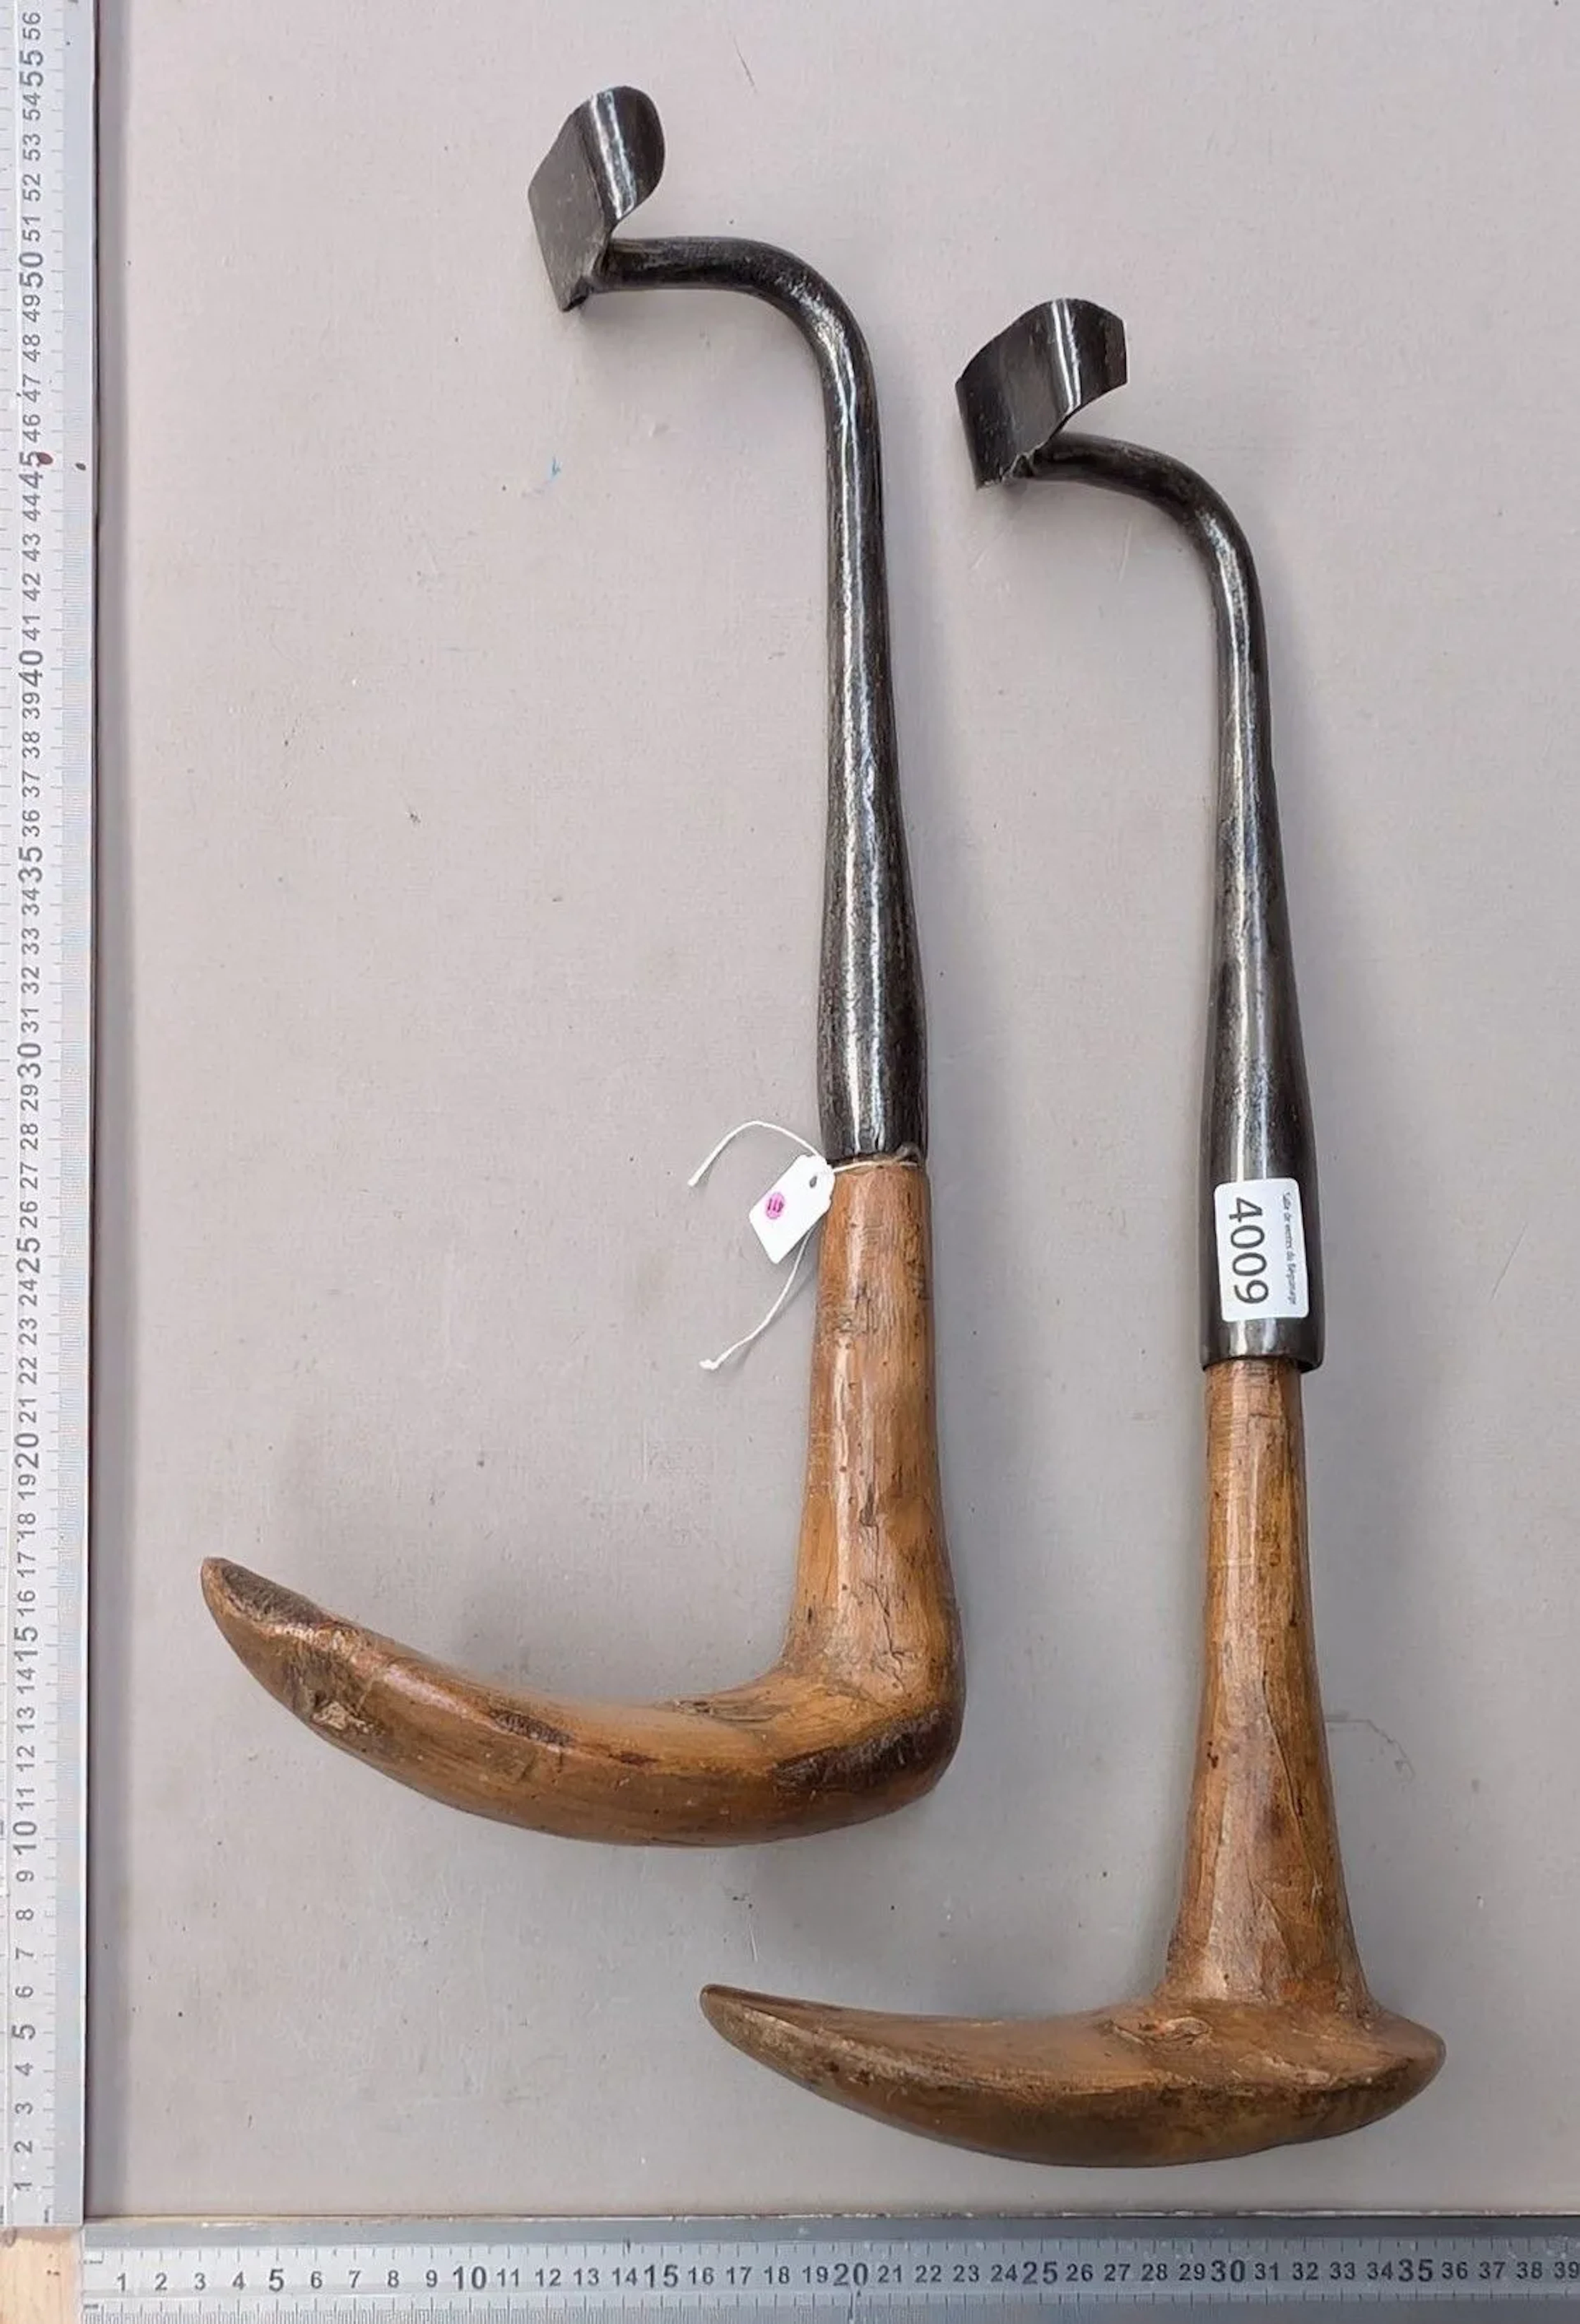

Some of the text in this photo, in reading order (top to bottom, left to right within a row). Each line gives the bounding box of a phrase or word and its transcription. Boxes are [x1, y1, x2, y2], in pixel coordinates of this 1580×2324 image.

[22, 13, 41, 40] 56
[19, 50, 43, 87] 55
[23, 93, 40, 121] 54
[23, 134, 41, 161] 53
[22, 174, 41, 201] 52
[22, 217, 40, 242] 51
[19, 252, 43, 288] 50
[22, 295, 40, 323] 49
[23, 334, 40, 363] 48
[22, 374, 40, 402] 47
[23, 414, 41, 442] 46
[19, 452, 43, 489] 45
[22, 494, 40, 522] 44
[22, 533, 40, 562] 43
[22, 573, 40, 601] 42
[22, 616, 40, 641] 41
[19, 651, 43, 687] 40
[22, 692, 40, 719] 39
[22, 731, 40, 758] 38
[22, 770, 40, 798] 37
[22, 810, 40, 837] 36
[18, 847, 42, 883] 35
[21, 888, 40, 916] 34
[21, 928, 39, 955] 33
[21, 967, 39, 994] 32
[21, 1008, 39, 1033] 31
[17, 1043, 41, 1078] 30
[20, 1084, 38, 1111] 29
[20, 1124, 38, 1150] 28
[20, 1162, 37, 1189] 27
[20, 1201, 37, 1228] 26
[16, 1238, 40, 1273] 25
[1229, 1197, 1269, 1304] 4009
[18, 1279, 37, 1306] 24
[18, 1318, 37, 1345] 23
[18, 1357, 37, 1384] 22
[18, 1399, 36, 1423] 21
[14, 1433, 39, 1468] 20
[18, 1474, 35, 1500] 19
[17, 1513, 35, 1539] 18
[17, 1552, 35, 1578] 17
[17, 1591, 35, 1617] 16
[14, 1627, 38, 1661] 15
[16, 1668, 35, 1694] 14
[16, 1707, 35, 1733] 13
[16, 1746, 35, 1772] 12
[16, 1789, 35, 1810] 11
[13, 1822, 37, 1855] 10
[16, 1870, 34, 1882] 9
[16, 1909, 34, 1921] 8
[16, 1947, 34, 1960] 7
[15, 1986, 33, 1998] 6
[11, 2024, 35, 2040] 5
[14, 2063, 33, 2076] 4
[14, 2102, 33, 2115] 3
[14, 2141, 32, 2153] 2
[117, 2259, 1579, 2292] 1 2 3 4 5 6 7 8 9 10 11 12 13 14 15 16 17 18 19 20 21 22 23 24 25 26 27 28 29 30 31 32 33 34 35 36 37 38 39
